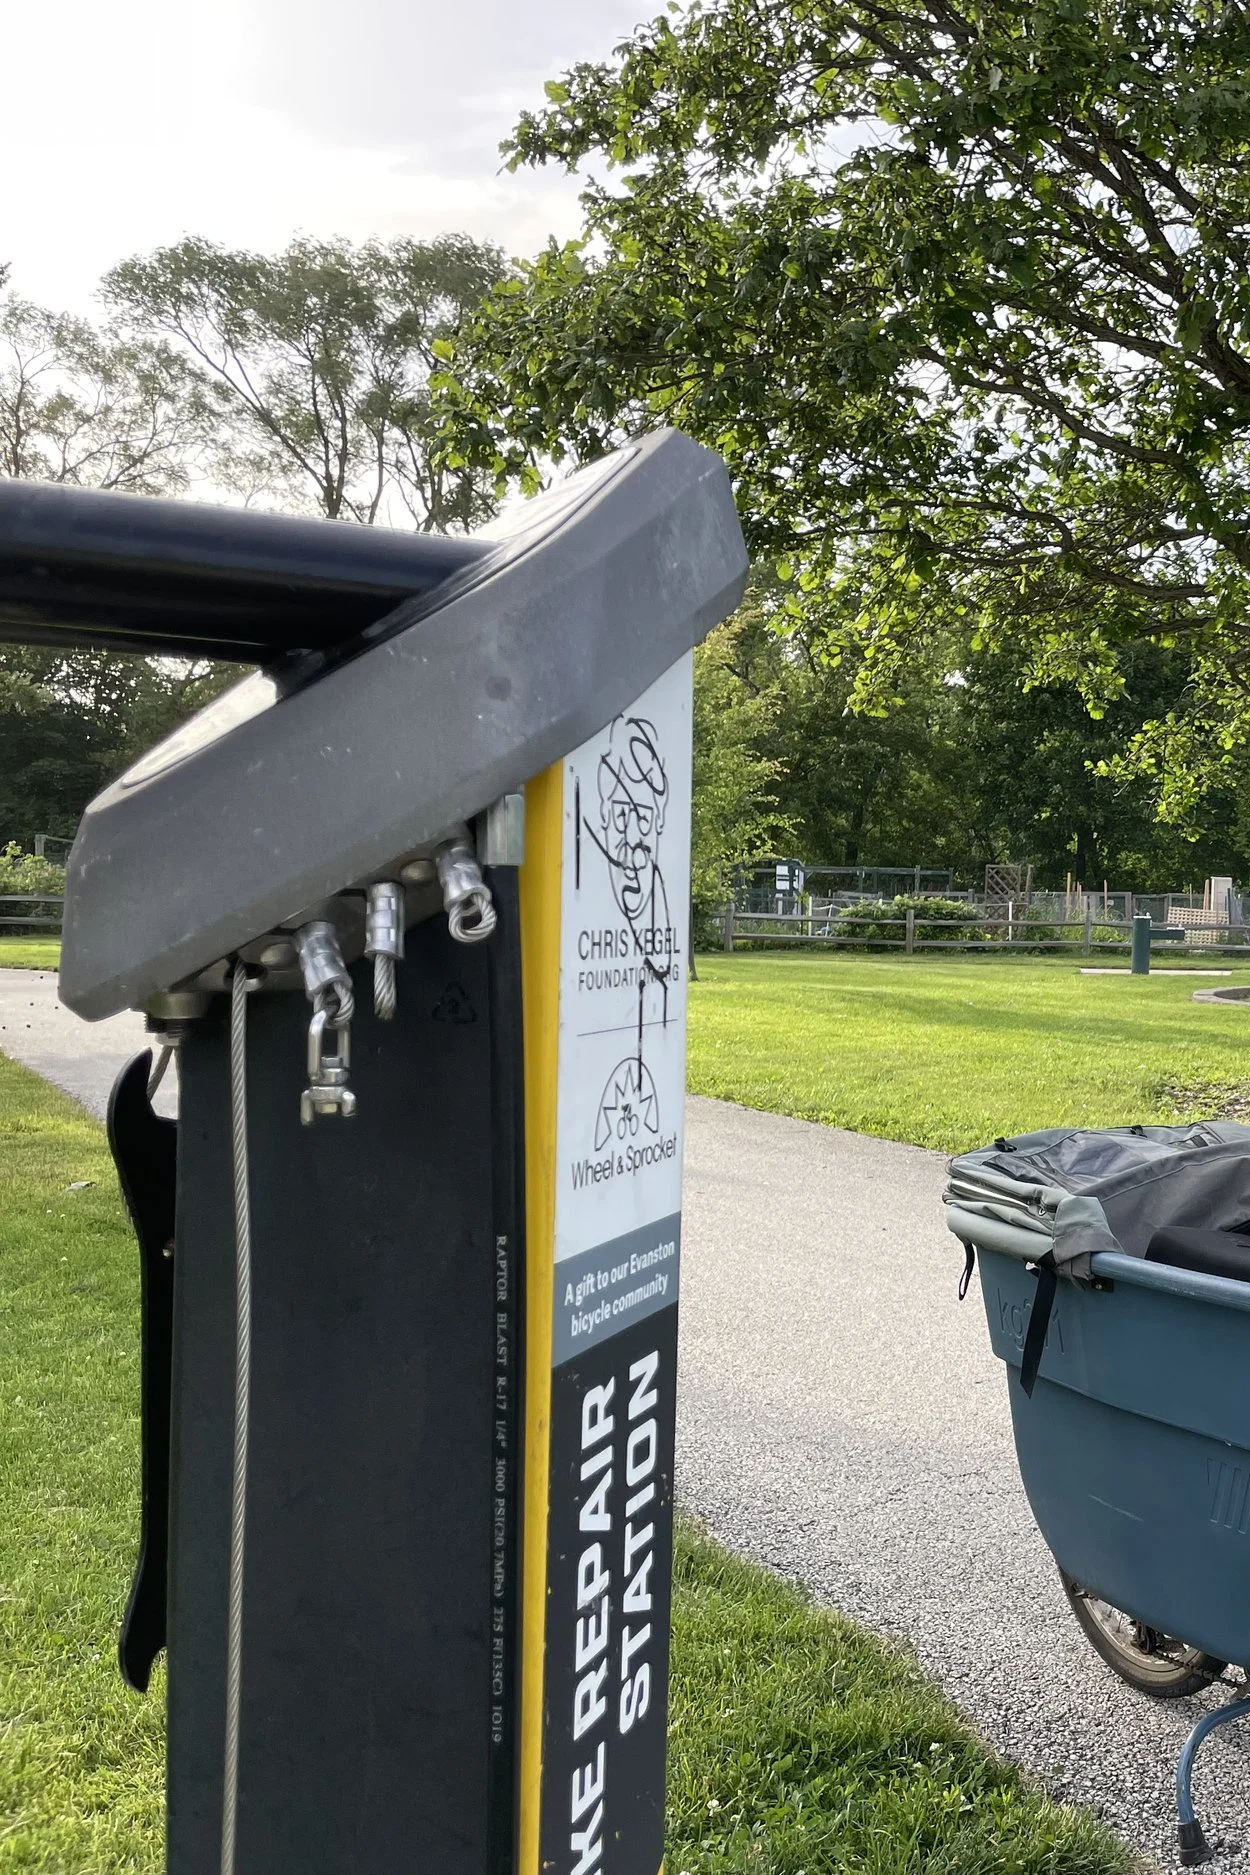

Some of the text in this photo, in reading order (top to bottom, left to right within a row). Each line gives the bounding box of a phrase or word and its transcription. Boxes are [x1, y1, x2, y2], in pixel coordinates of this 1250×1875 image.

[578, 927, 681, 960] CHRIS KEGEL
[572, 1131, 677, 1191] Wheel & Sprocket
[496, 1235, 508, 1302] RAPTOR
[564, 1241, 676, 1306] A gift to our Evanston
[571, 1273, 669, 1337] bicycle community
[496, 1312, 507, 1366] BLAST
[496, 1376, 507, 1411] R-17
[495, 1457, 506, 1493] 3000
[619, 1349, 661, 1736] STATION
[570, 1375, 616, 1875] KE REPAIR
